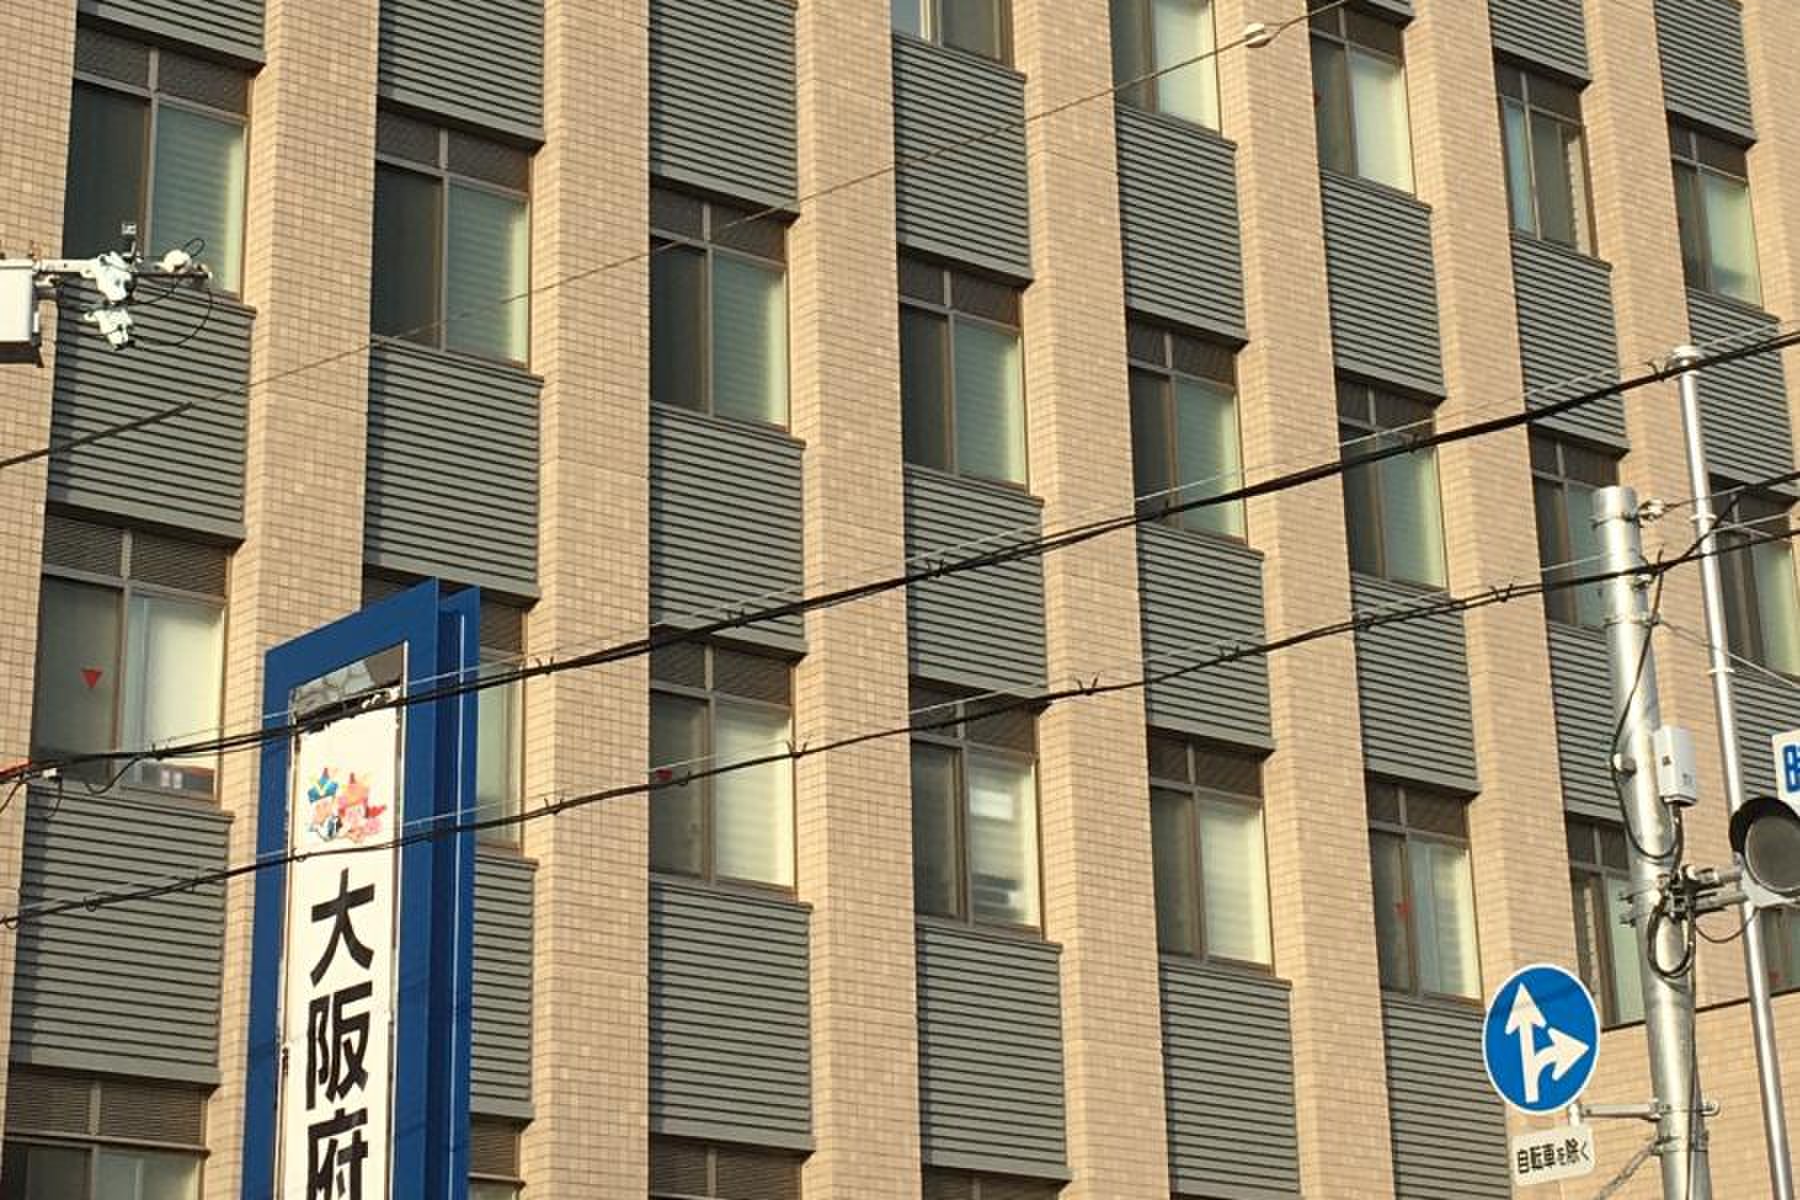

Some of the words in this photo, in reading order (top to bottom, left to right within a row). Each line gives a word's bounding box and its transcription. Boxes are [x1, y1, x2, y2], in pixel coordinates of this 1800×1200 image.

[306, 867, 375, 1200] 大阪府
[1517, 1138, 1589, 1174] 自転車を除く
